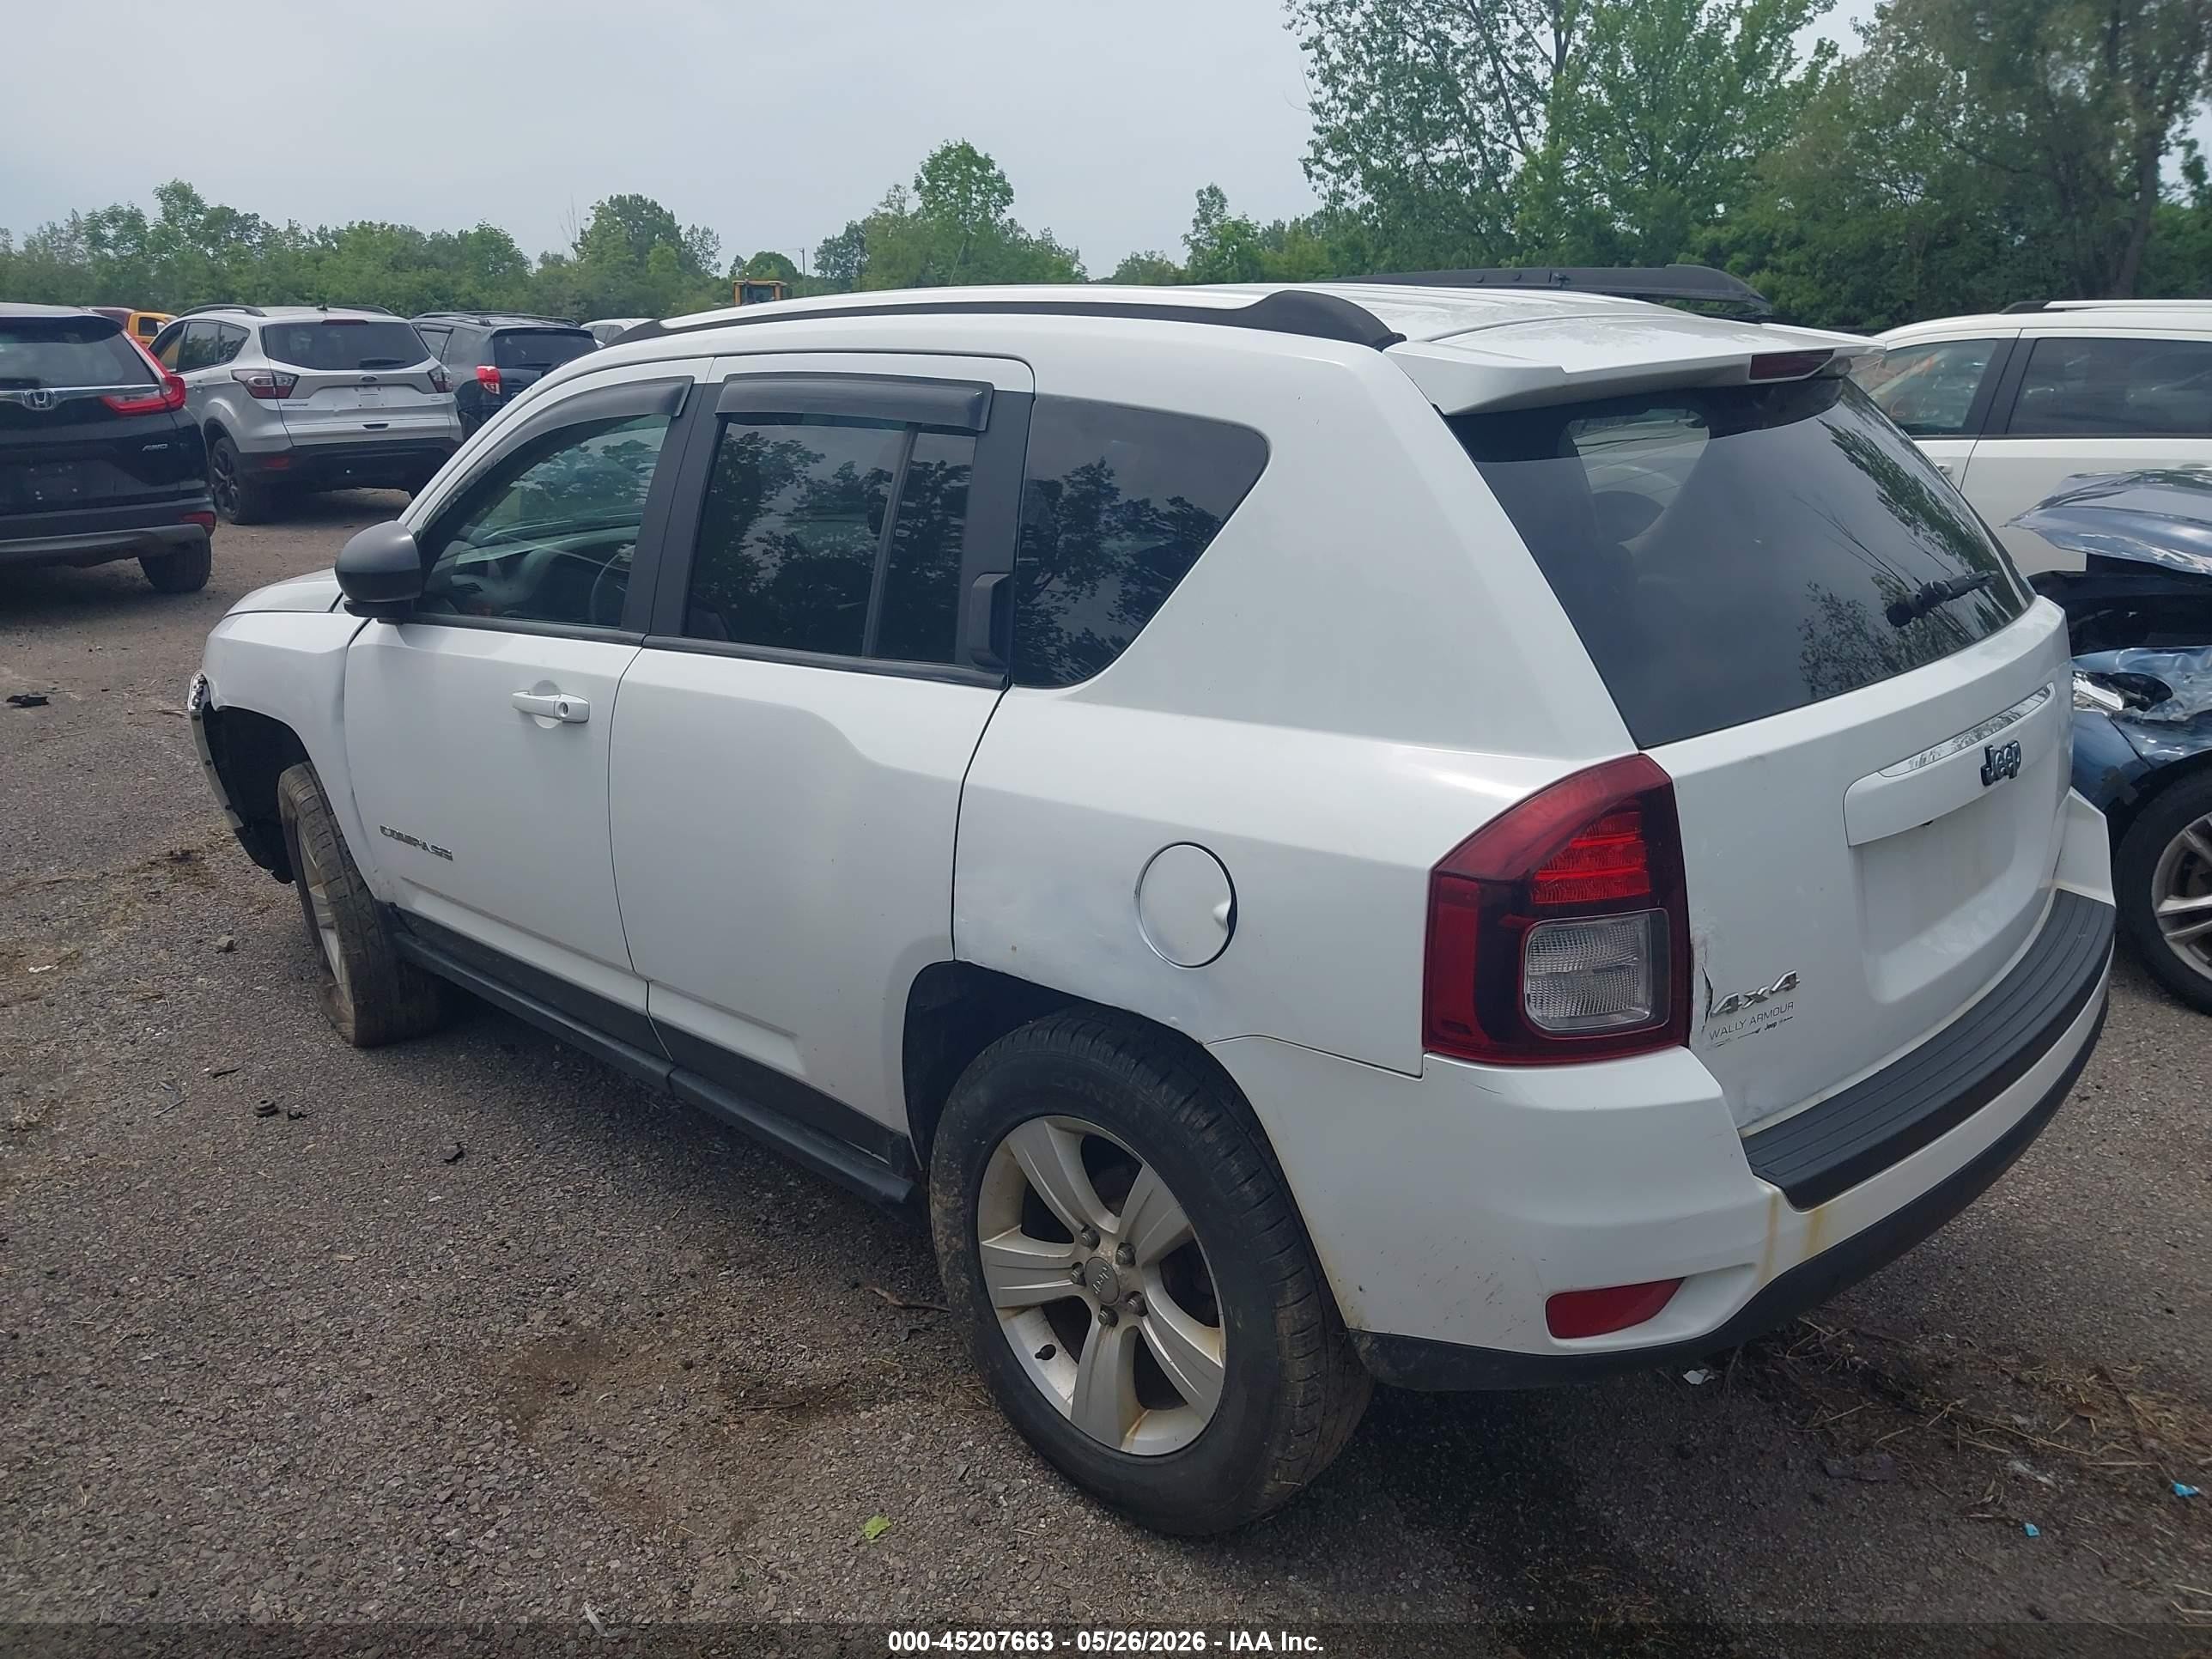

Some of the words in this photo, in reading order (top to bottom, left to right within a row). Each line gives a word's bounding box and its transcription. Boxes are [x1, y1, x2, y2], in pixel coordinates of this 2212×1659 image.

[1980, 739, 2022, 787] Jeep
[380, 824, 453, 861] COMPASS
[1709, 1018, 1747, 1041] WALLY
[1749, 1001, 1795, 1026] ARMOUR
